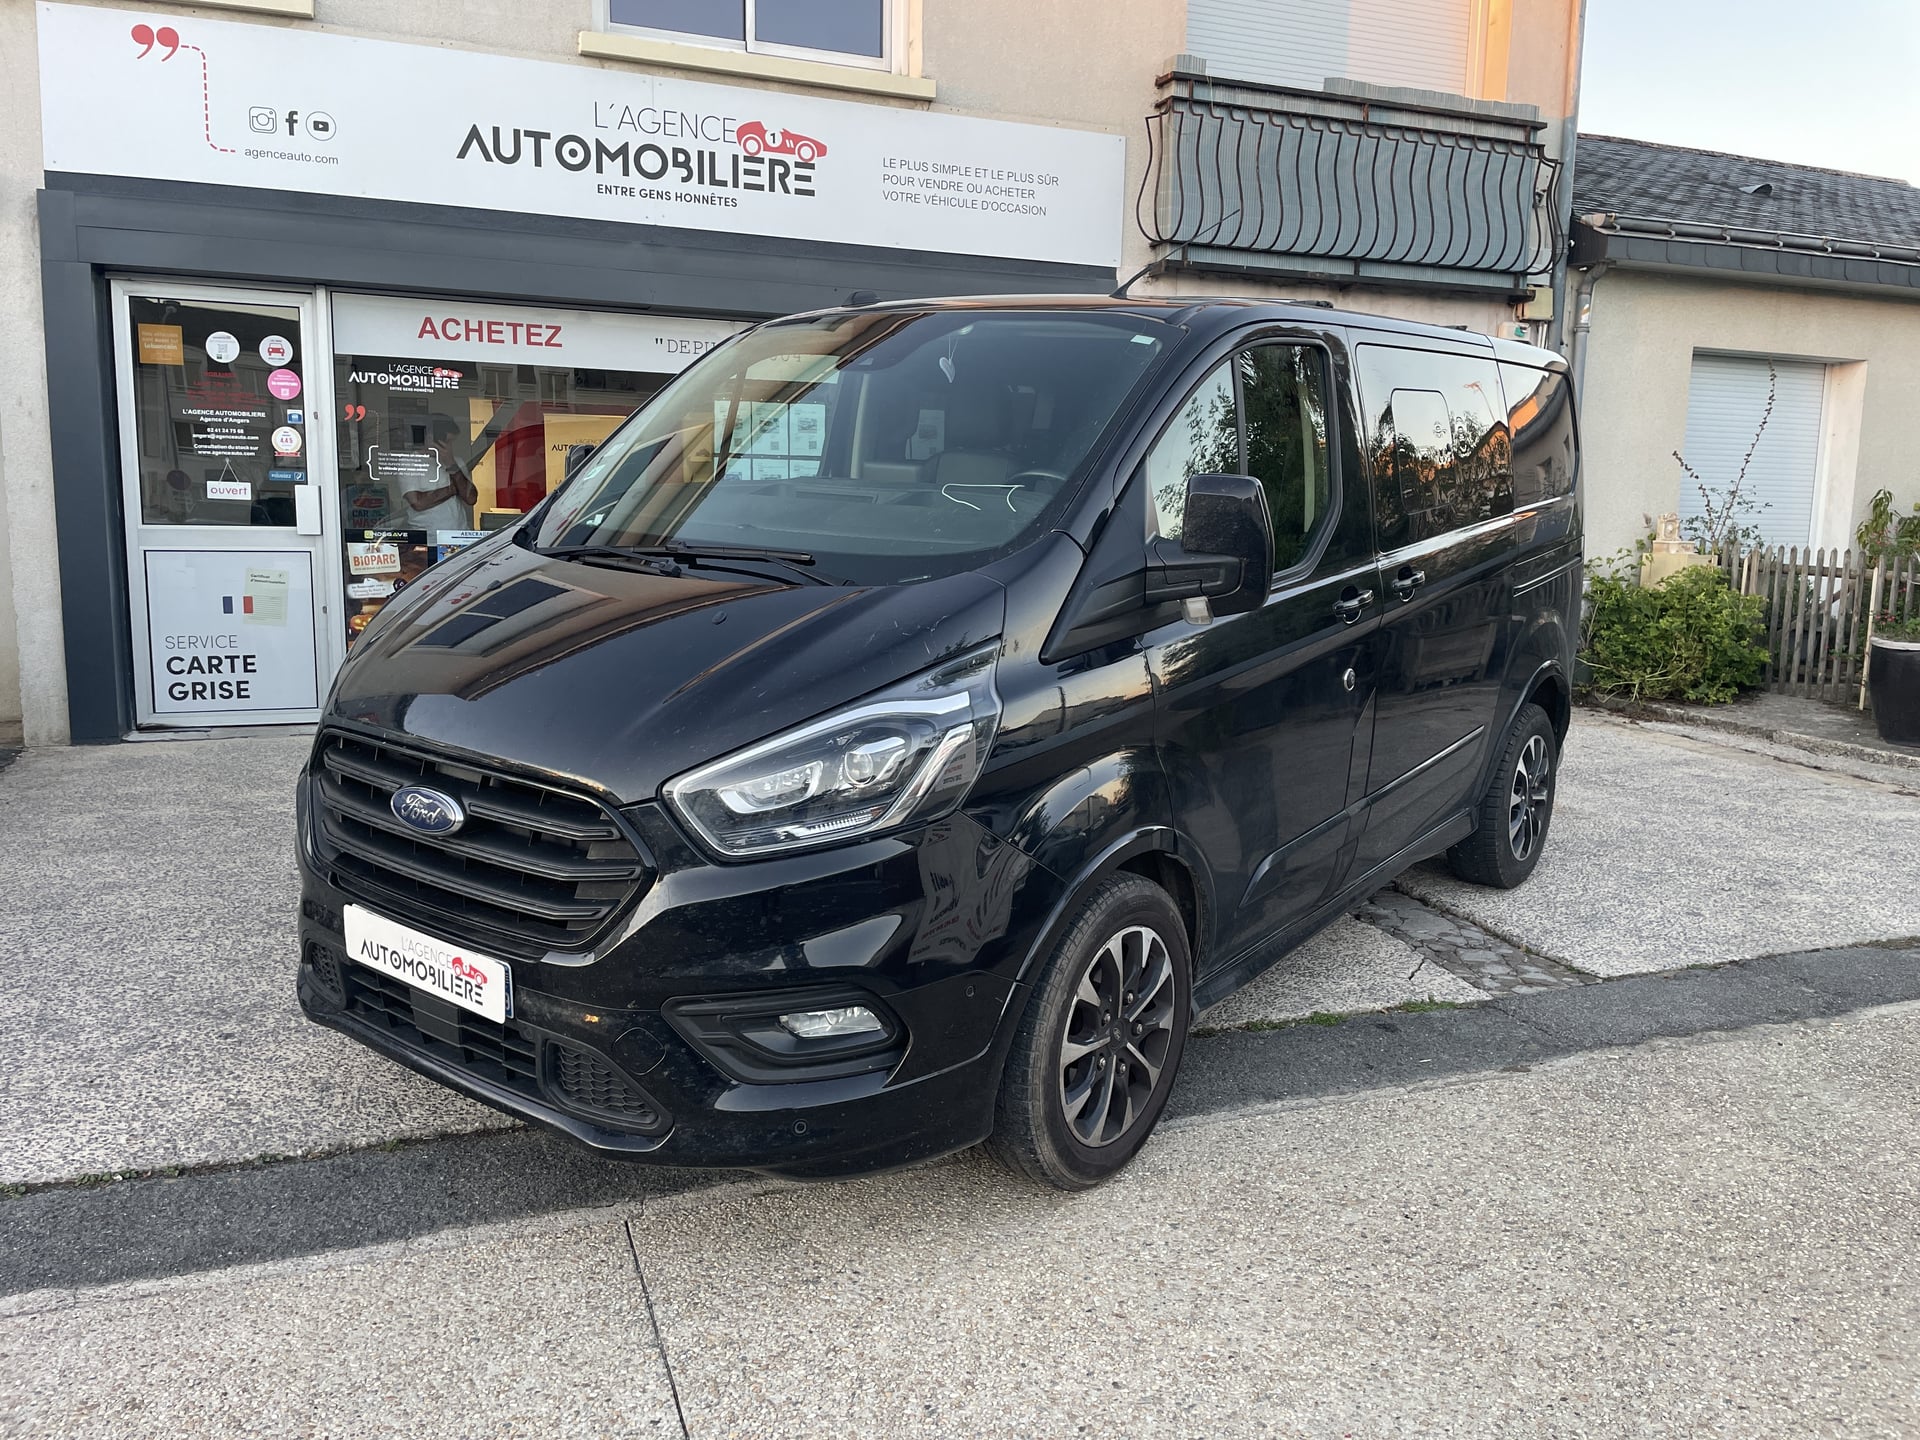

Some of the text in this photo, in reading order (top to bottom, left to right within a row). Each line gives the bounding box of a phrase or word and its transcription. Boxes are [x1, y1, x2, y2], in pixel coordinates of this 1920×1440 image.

[244, 148, 339, 165] agenceauto.com
[882, 157, 1060, 186] LE PLUS SIMPLE ET LE PLUS SÛR
[597, 184, 738, 207] ENTRE GENS HONNÊTES
[882, 173, 1036, 200] POUR VENDRE OU ACHETER
[882, 190, 1047, 216] VOTRE VÉHICULE D'OCCASION
[417, 316, 563, 348] ACHETEZ
[210, 487, 248, 495] ouvert
[165, 635, 238, 649] SERVICE
[166, 655, 257, 675] CARTE
[168, 681, 251, 701] GRISE
[401, 793, 446, 825] Ford
